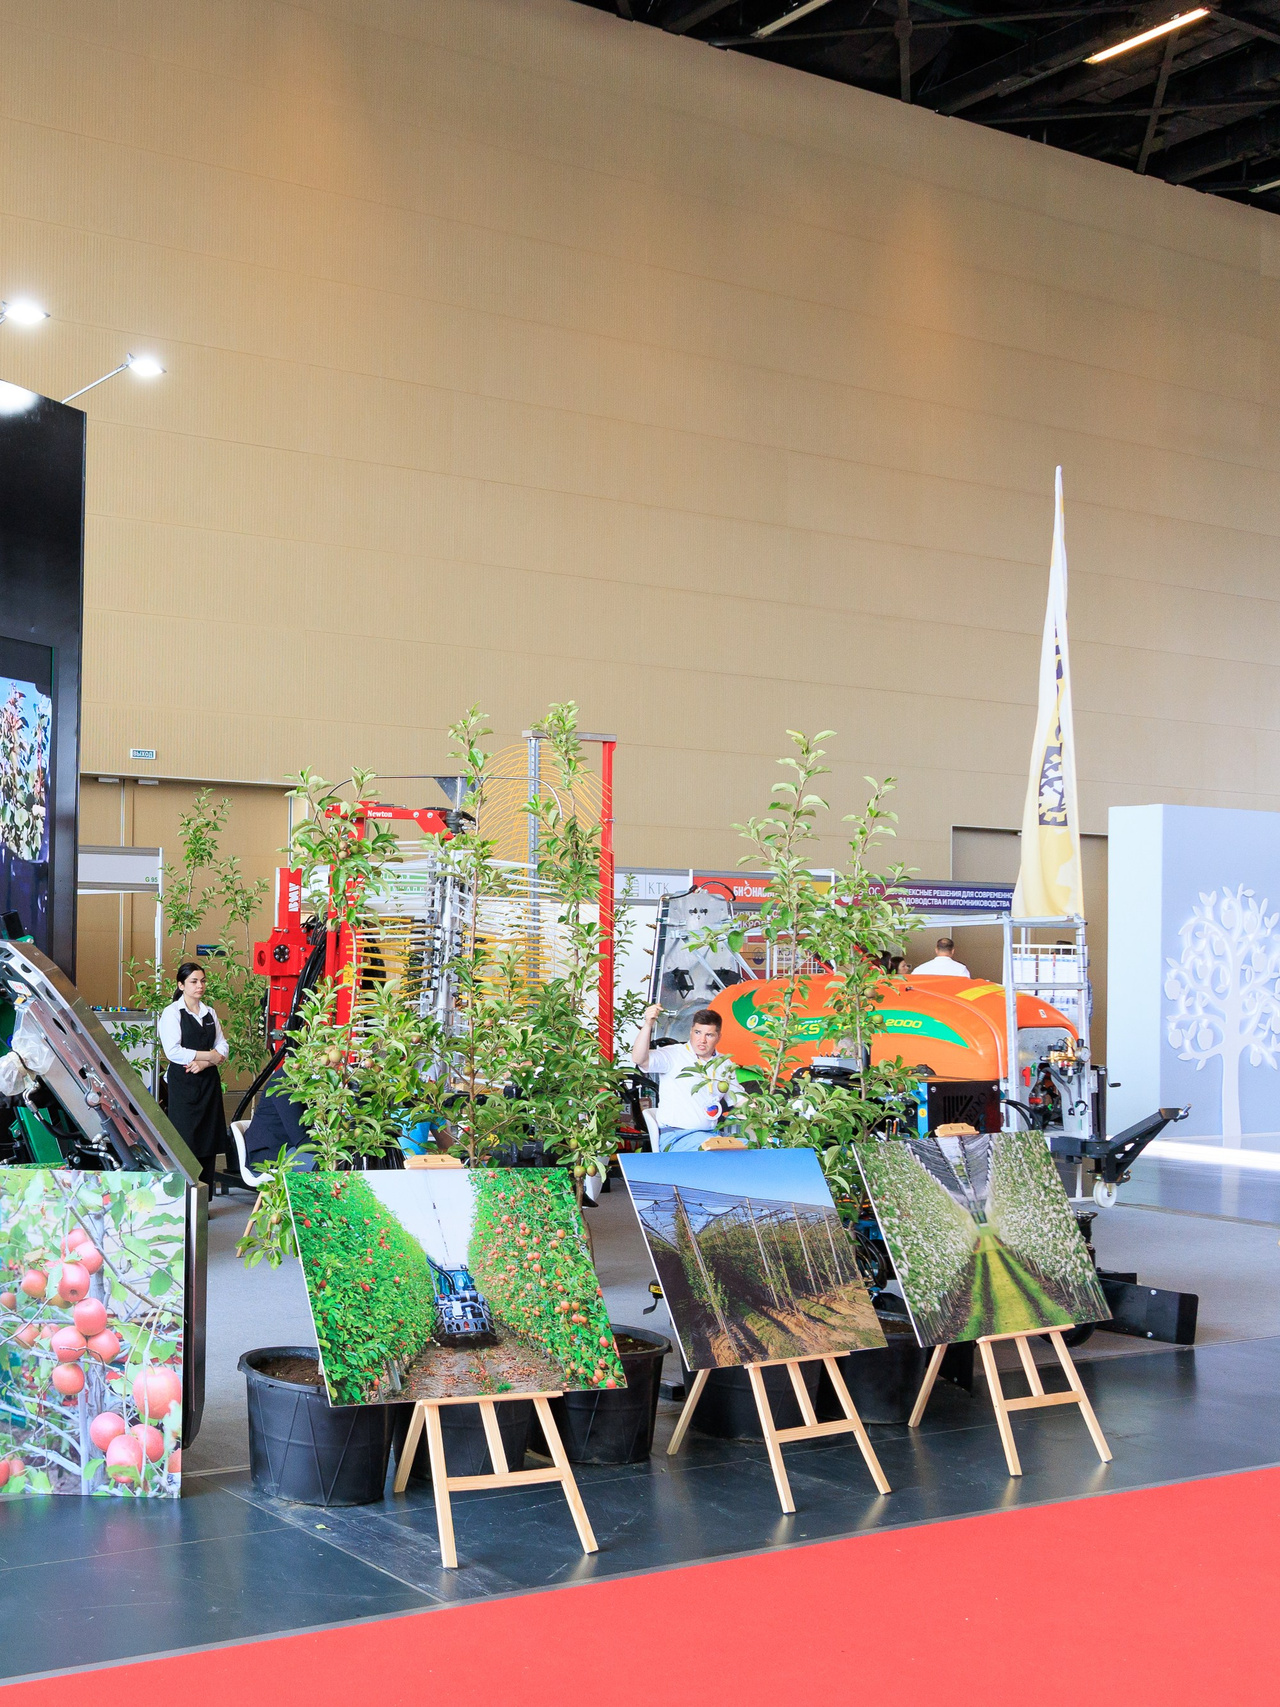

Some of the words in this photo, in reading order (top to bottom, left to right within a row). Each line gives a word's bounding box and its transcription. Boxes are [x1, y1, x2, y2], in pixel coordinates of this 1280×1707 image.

[367, 810, 393, 818] Newton
[933, 889, 961, 898] РЕШЕНИЯ
[962, 890, 974, 898] ДЛЯ
[948, 899, 1010, 907] ПИТОМНИКОВОДСТВА
[885, 1018, 923, 1028] 2000
